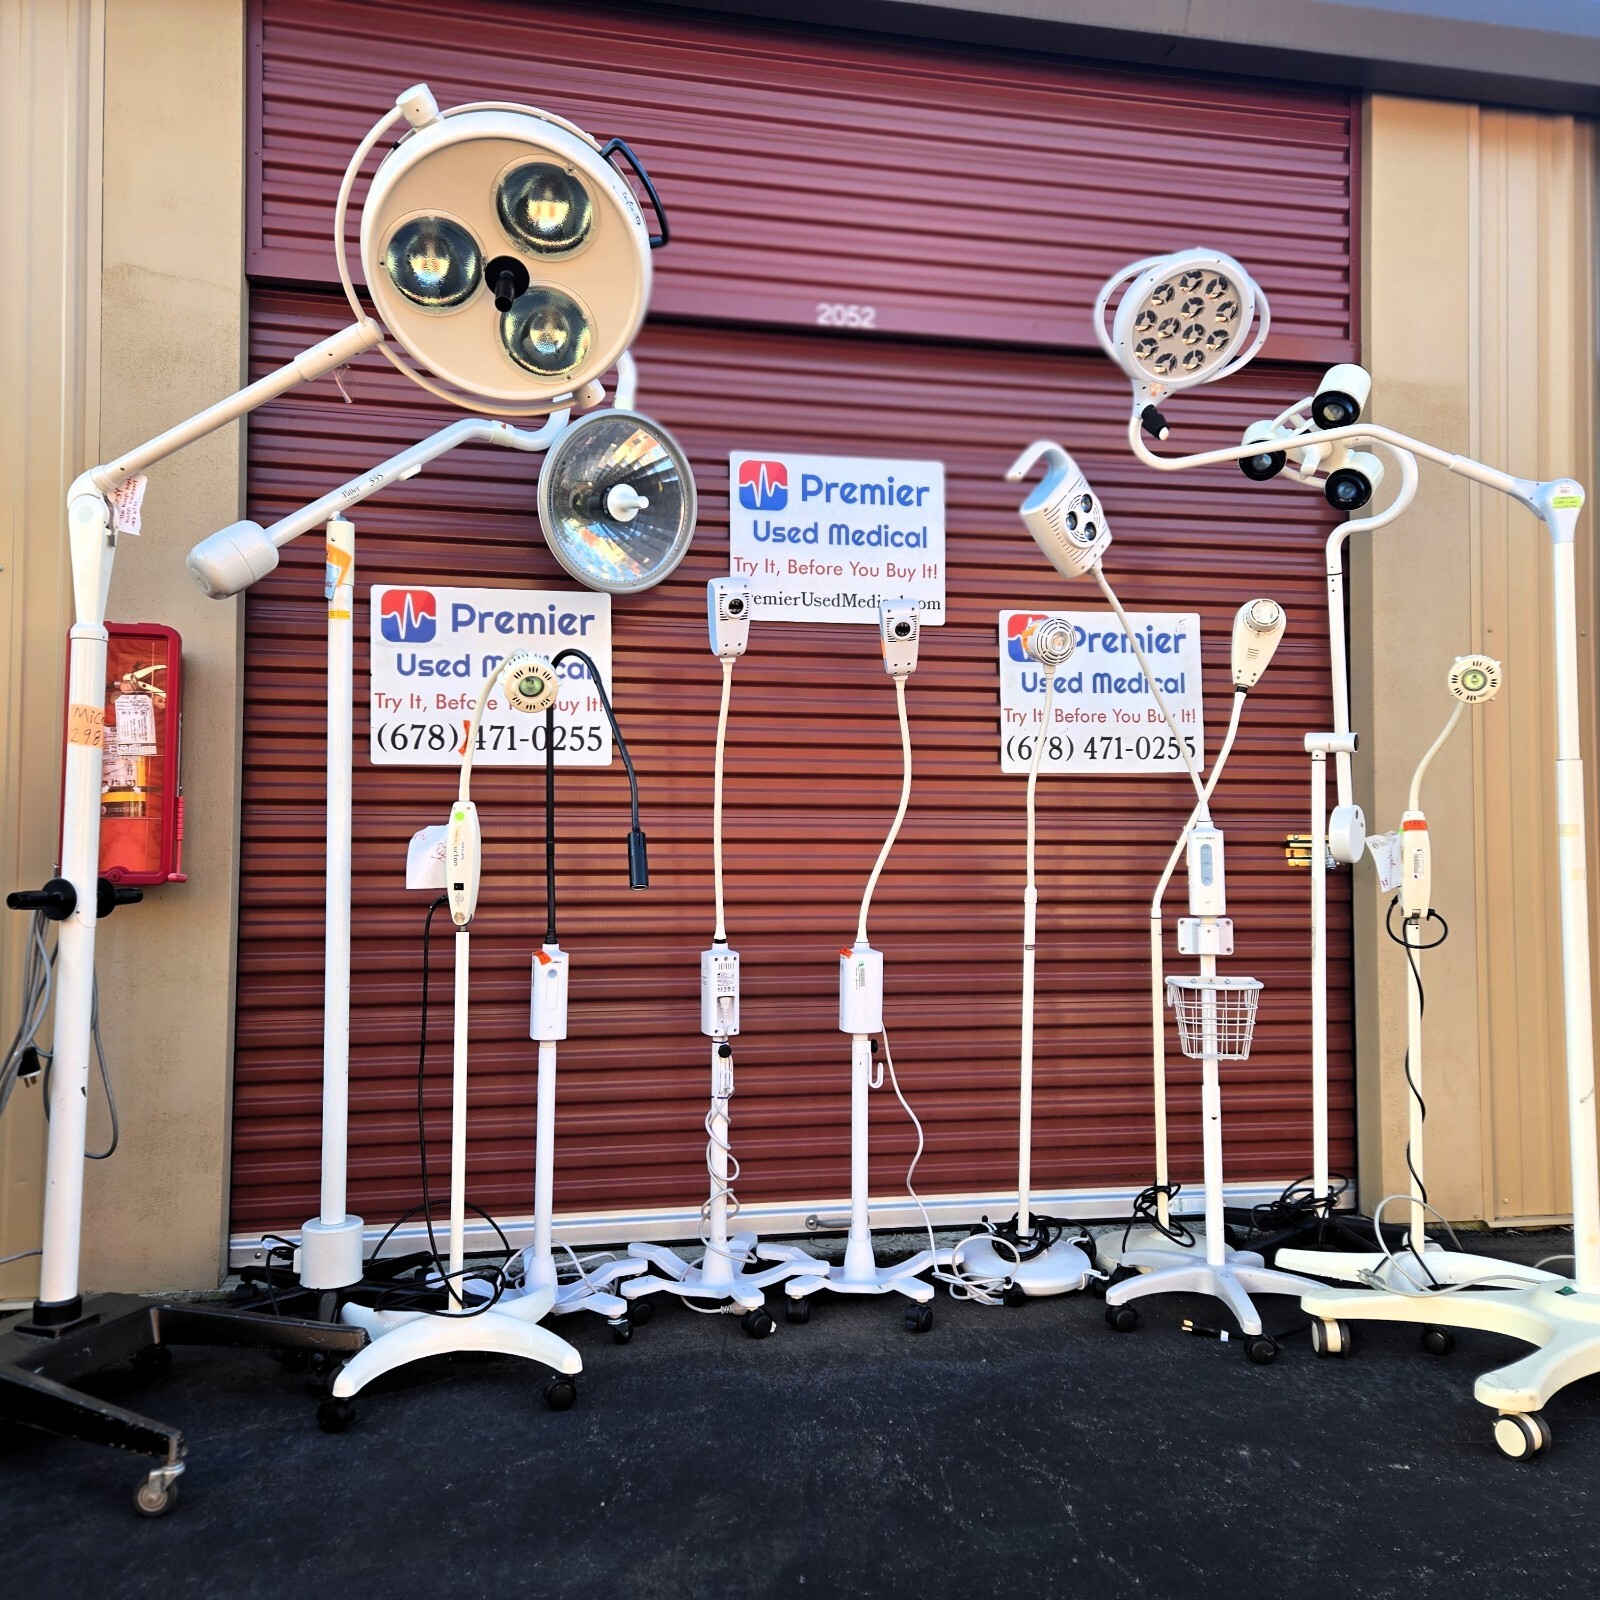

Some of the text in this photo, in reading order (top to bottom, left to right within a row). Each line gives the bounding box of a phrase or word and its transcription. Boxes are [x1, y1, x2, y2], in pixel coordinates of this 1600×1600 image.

[816, 302, 877, 328] 2052
[802, 474, 930, 507] Premier
[753, 520, 927, 548] Used Medical
[734, 557, 937, 582] Try It, Before You Buy It!
[452, 603, 595, 636] Premier
[396, 653, 470, 678] Used
[374, 693, 402, 713] Try
[410, 693, 427, 712] It,
[436, 693, 498, 711] Befoe
[586, 696, 603, 712] It!
[1004, 708, 1196, 727] Try It Before You Bu It!
[70, 728, 101, 746] 298
[377, 723, 459, 752] (678)
[1084, 736, 1196, 760] 471-0255
